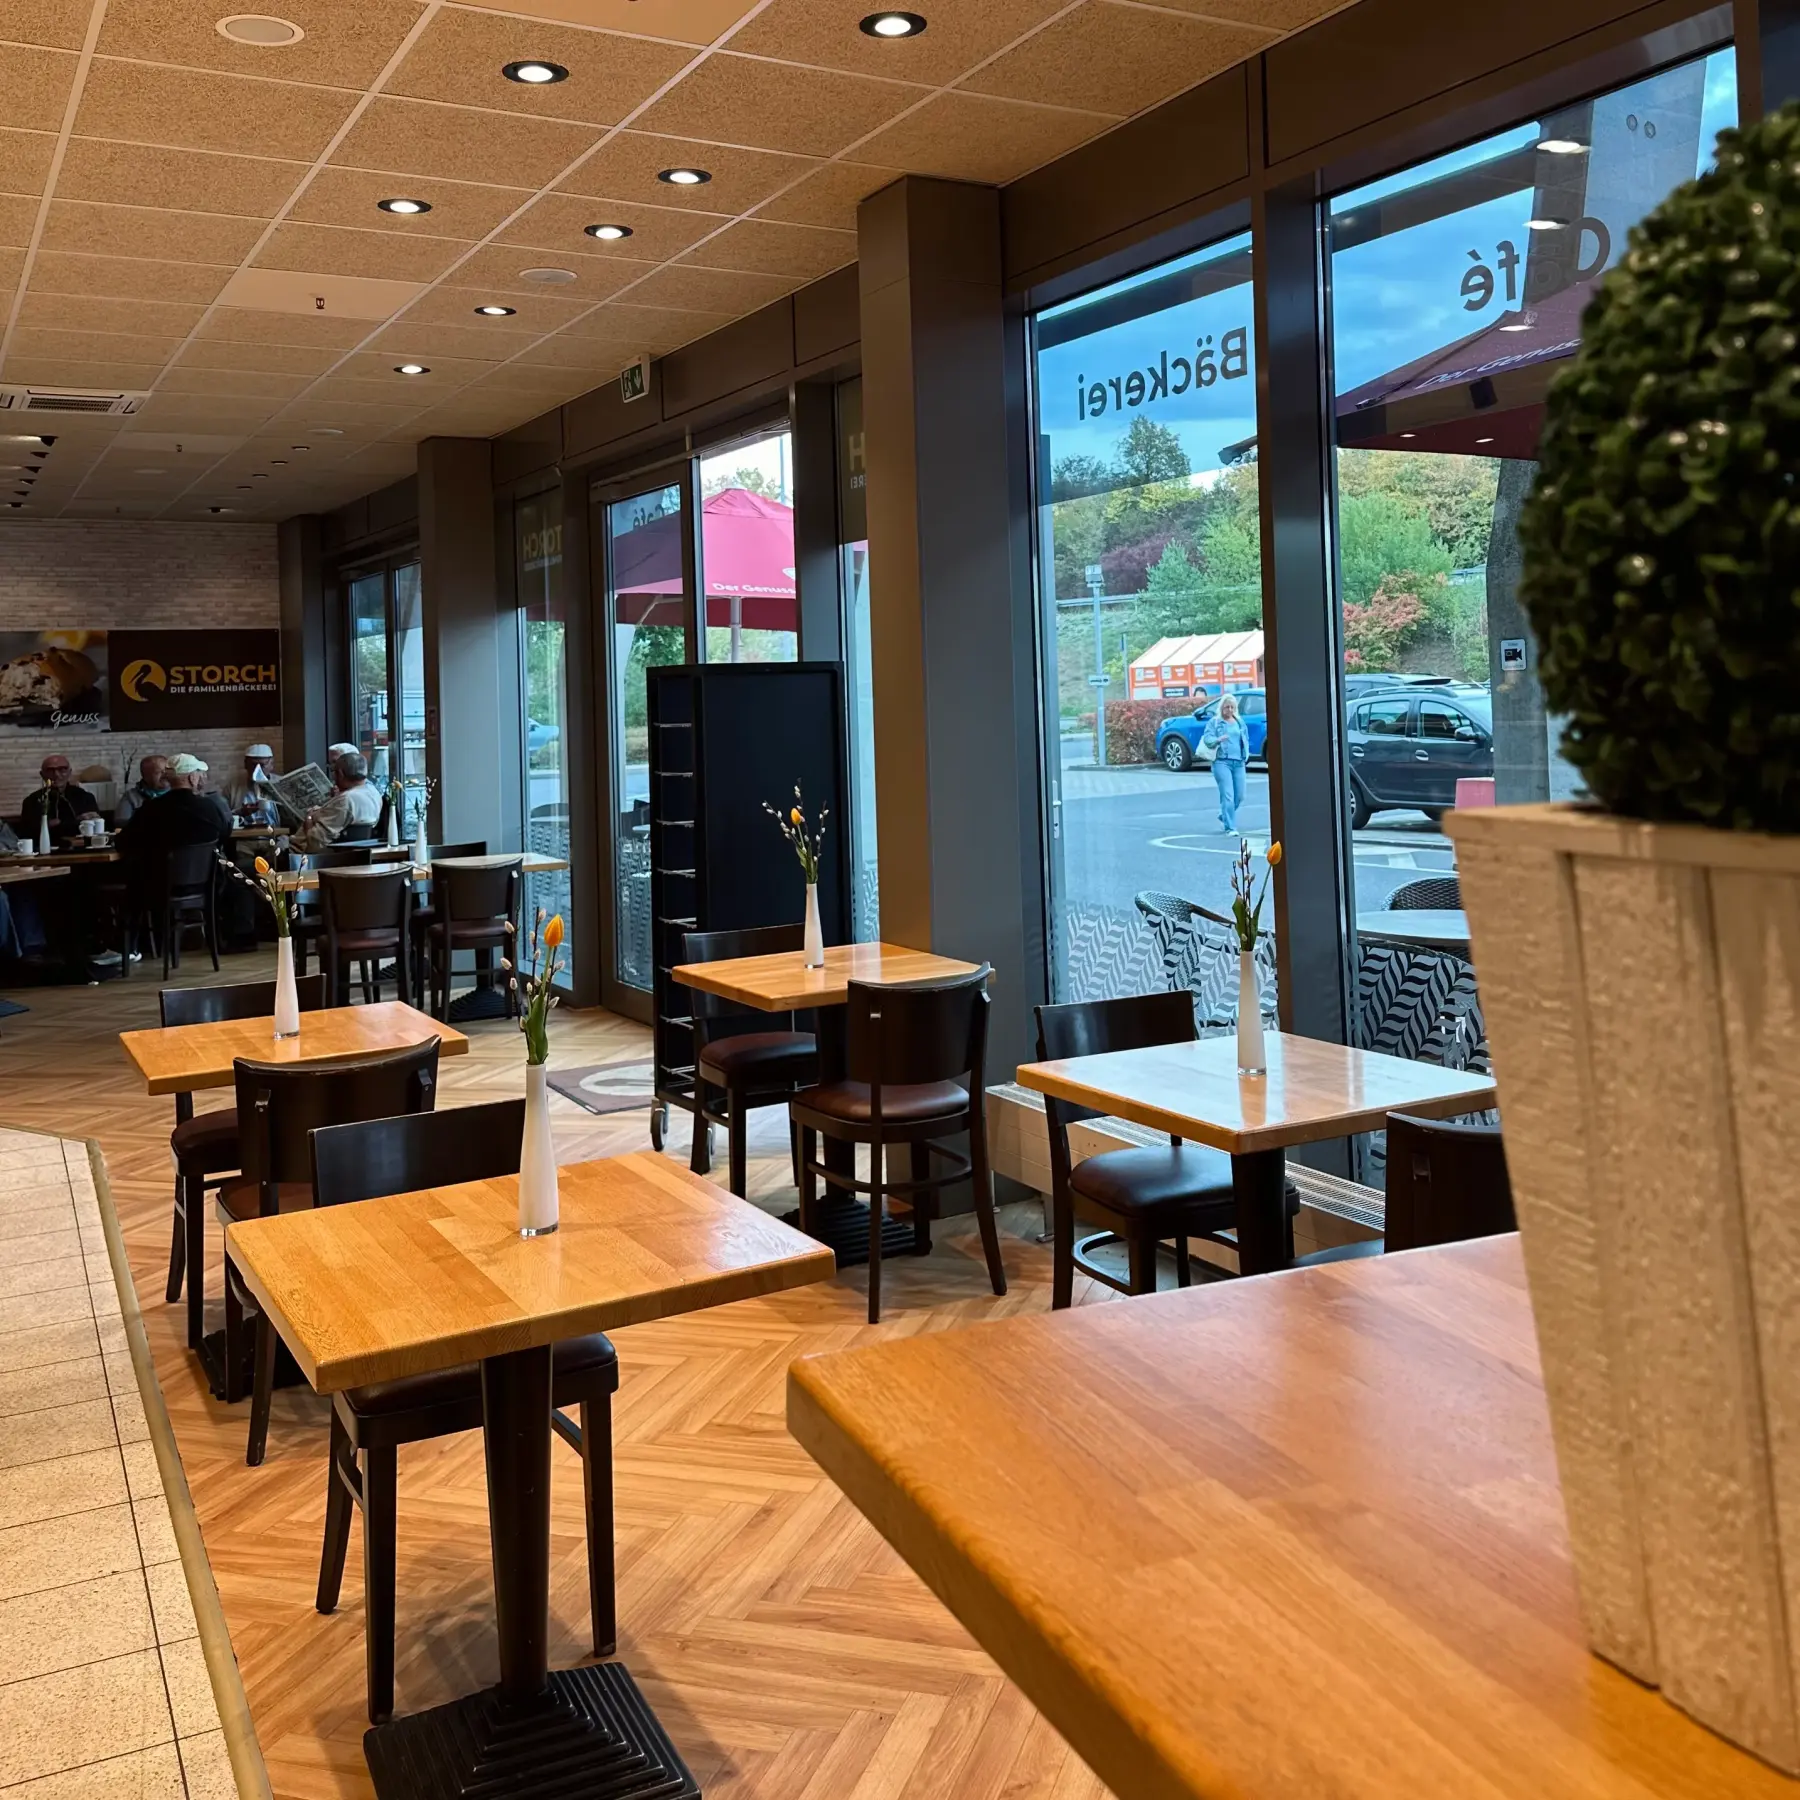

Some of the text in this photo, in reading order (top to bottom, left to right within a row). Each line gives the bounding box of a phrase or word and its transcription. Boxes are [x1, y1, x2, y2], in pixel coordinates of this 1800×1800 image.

[1414, 338, 1582, 390] Der Genus
[712, 582, 739, 592] Der
[170, 664, 276, 685] STORCH
[170, 683, 277, 693] DIE FAMILIENBÄCKEREI
[50, 709, 100, 730] Genuss
